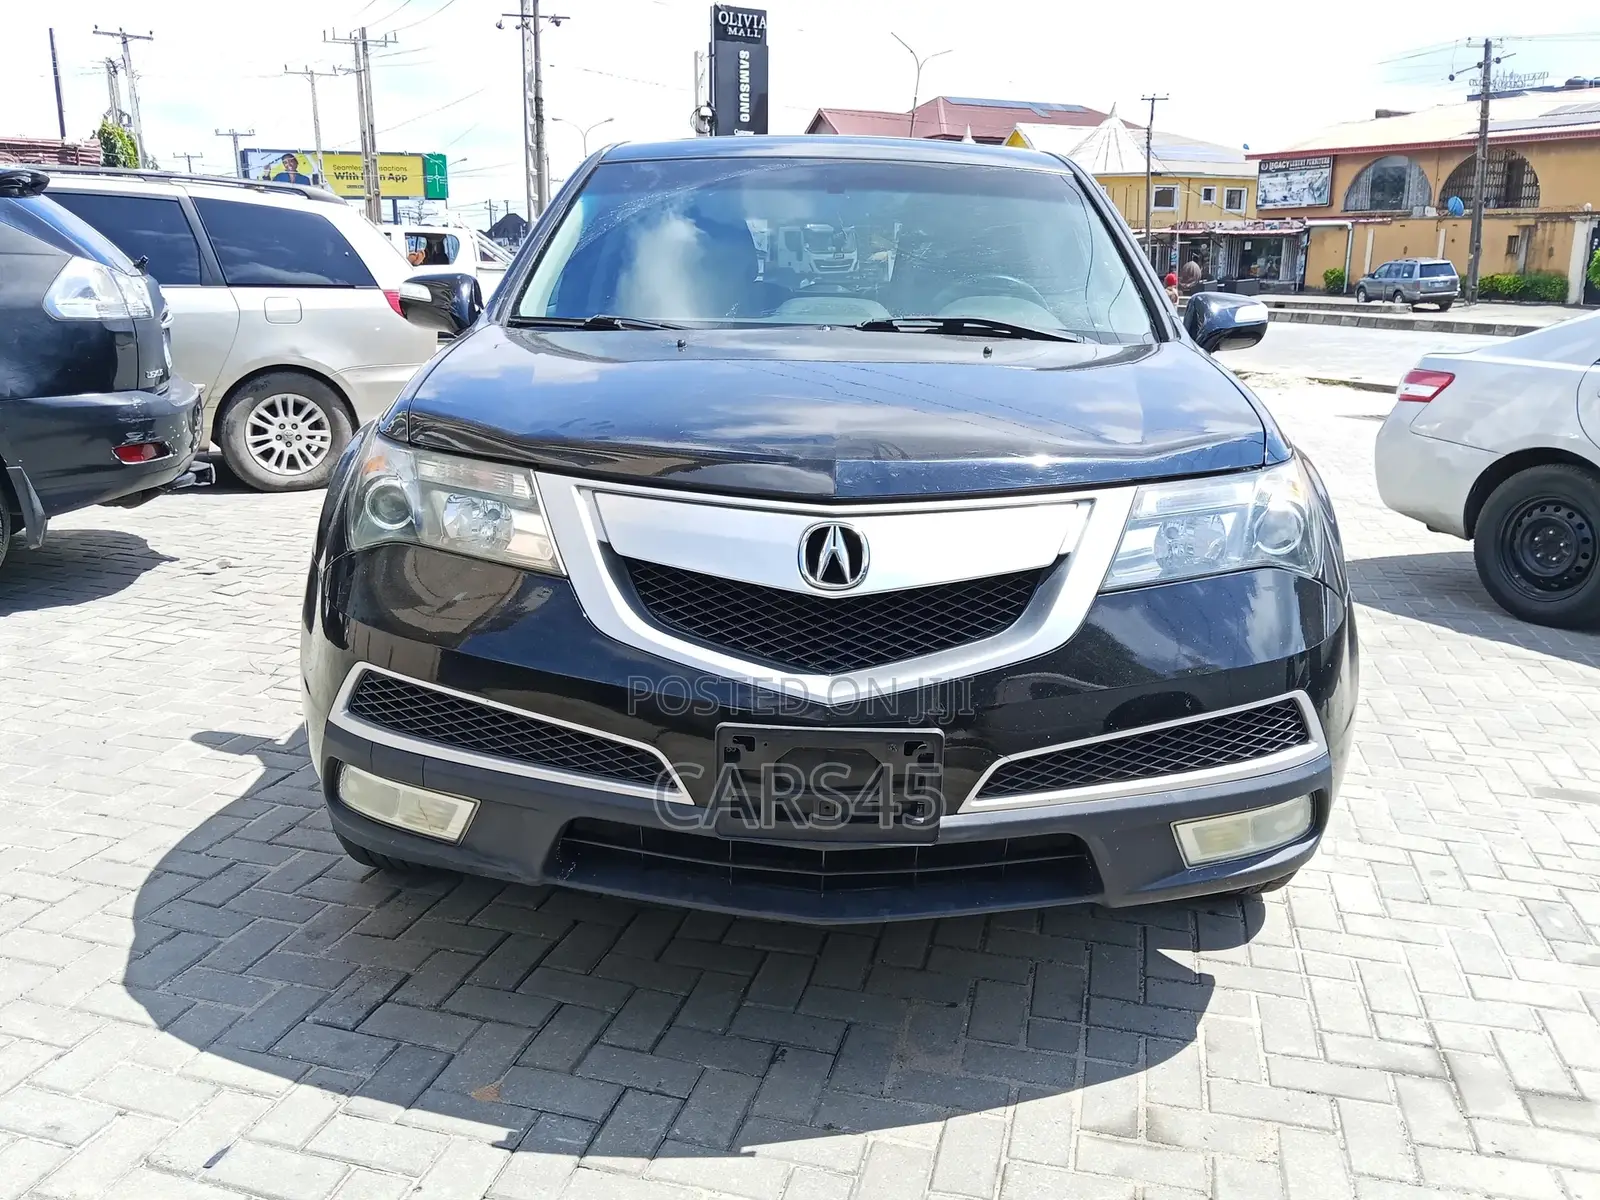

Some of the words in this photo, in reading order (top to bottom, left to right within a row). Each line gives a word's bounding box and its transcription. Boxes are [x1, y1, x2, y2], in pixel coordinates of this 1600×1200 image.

[718, 10, 766, 28] OLIVIA
[727, 26, 761, 38] MALL
[1269, 161, 1289, 172] LEGACY
[334, 172, 359, 180] With
[387, 173, 408, 183] App
